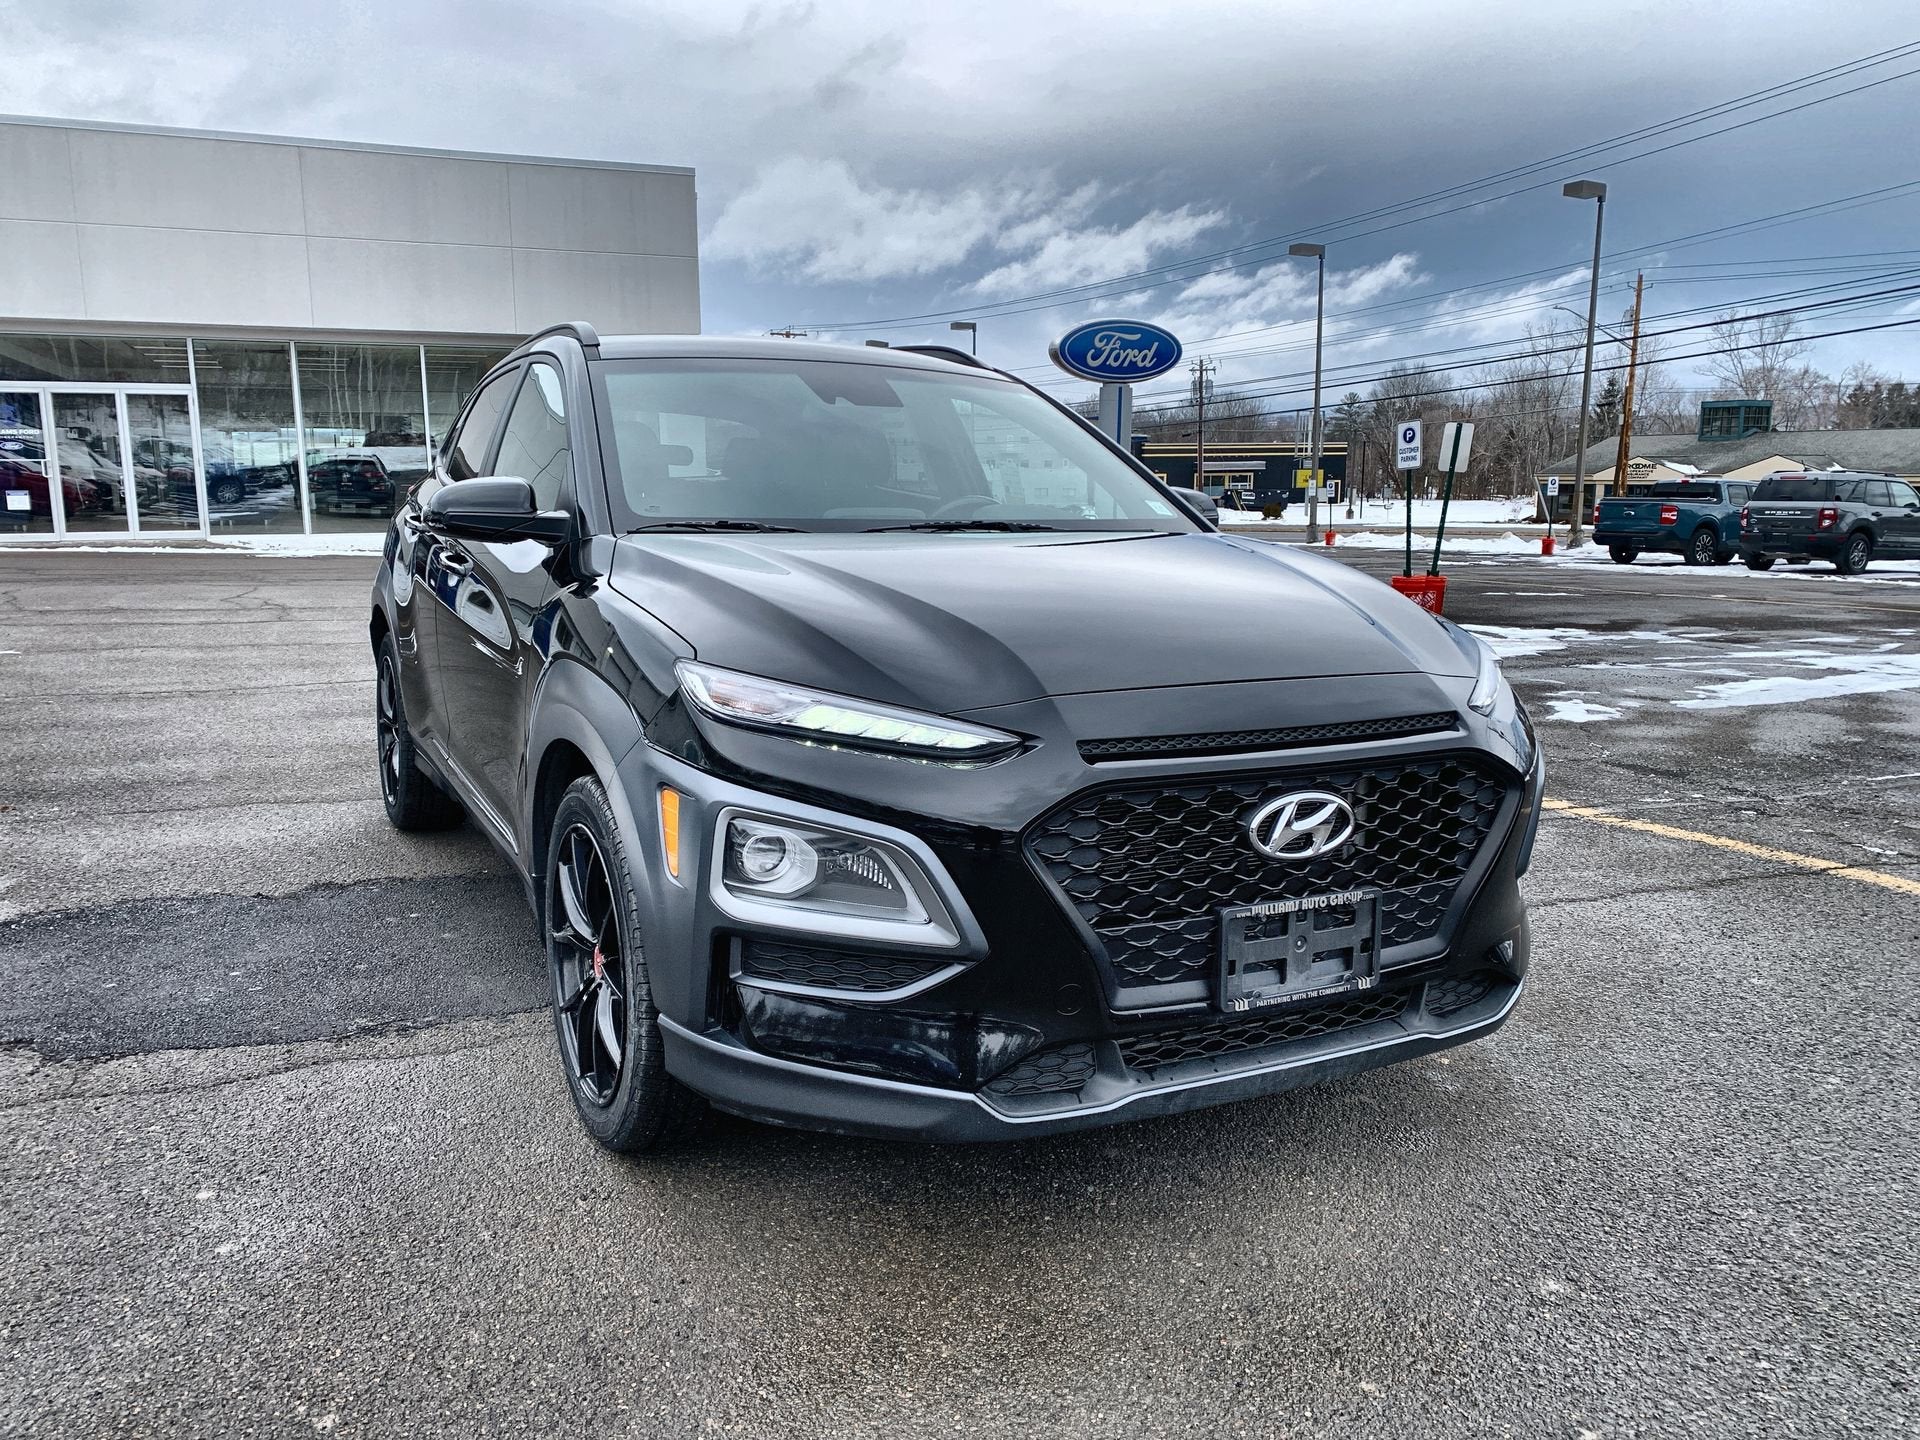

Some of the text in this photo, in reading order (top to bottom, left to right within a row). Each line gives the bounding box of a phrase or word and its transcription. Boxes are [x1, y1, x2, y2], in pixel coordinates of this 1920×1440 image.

[1086, 330, 1159, 369] Ford
[1399, 446, 1419, 455] CUSTOMER
[1400, 454, 1418, 463] PARKING
[1302, 896, 1327, 910] AUTO
[1256, 984, 1351, 1008] PARTNERING WITH THE COMMUNITY
